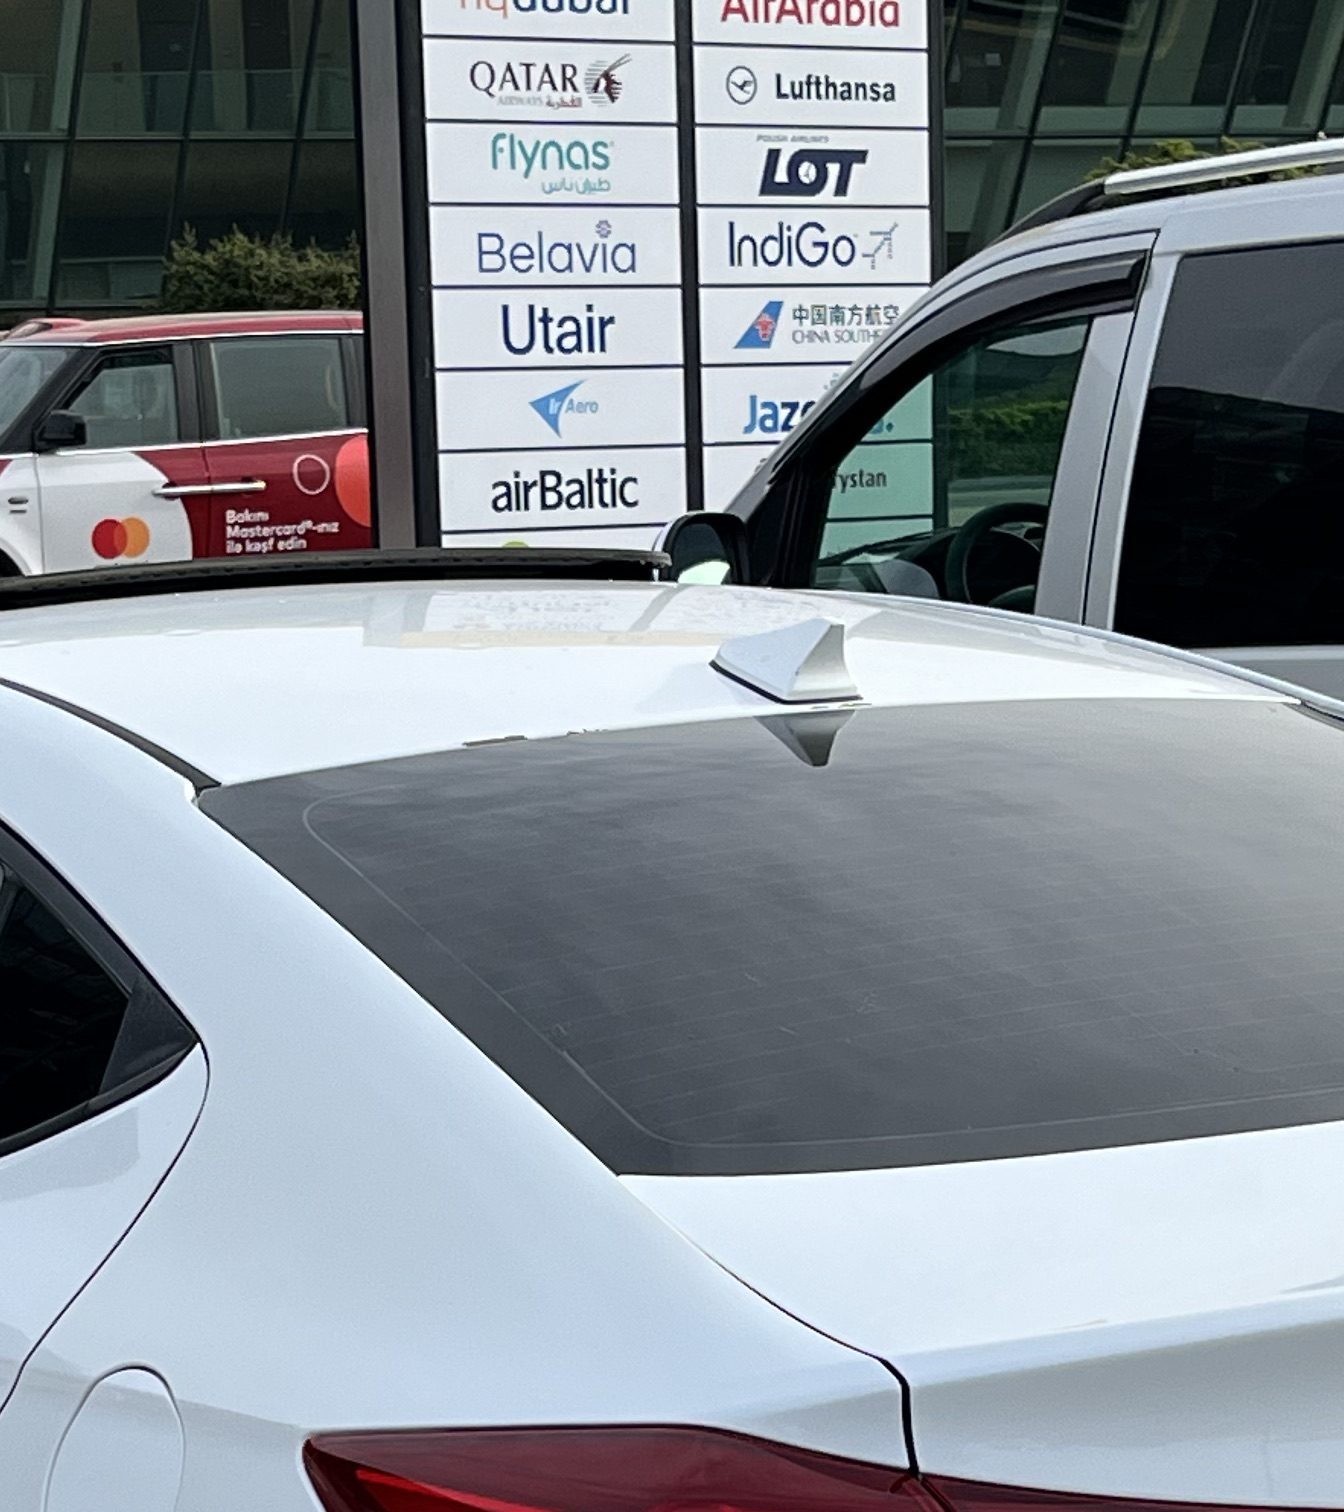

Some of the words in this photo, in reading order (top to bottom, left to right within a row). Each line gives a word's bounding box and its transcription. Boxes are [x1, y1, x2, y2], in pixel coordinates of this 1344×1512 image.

[721, 0, 899, 27] AirArabia
[470, 61, 579, 97] QATAR
[775, 73, 896, 102] Lufthansa
[491, 132, 610, 179] flynas
[758, 148, 869, 197] LOT
[477, 220, 637, 273] Belavia
[728, 221, 856, 267] IndiGo
[501, 304, 616, 355] Utair
[792, 304, 900, 326] 中国南方航空
[491, 467, 639, 513] airBaltic
